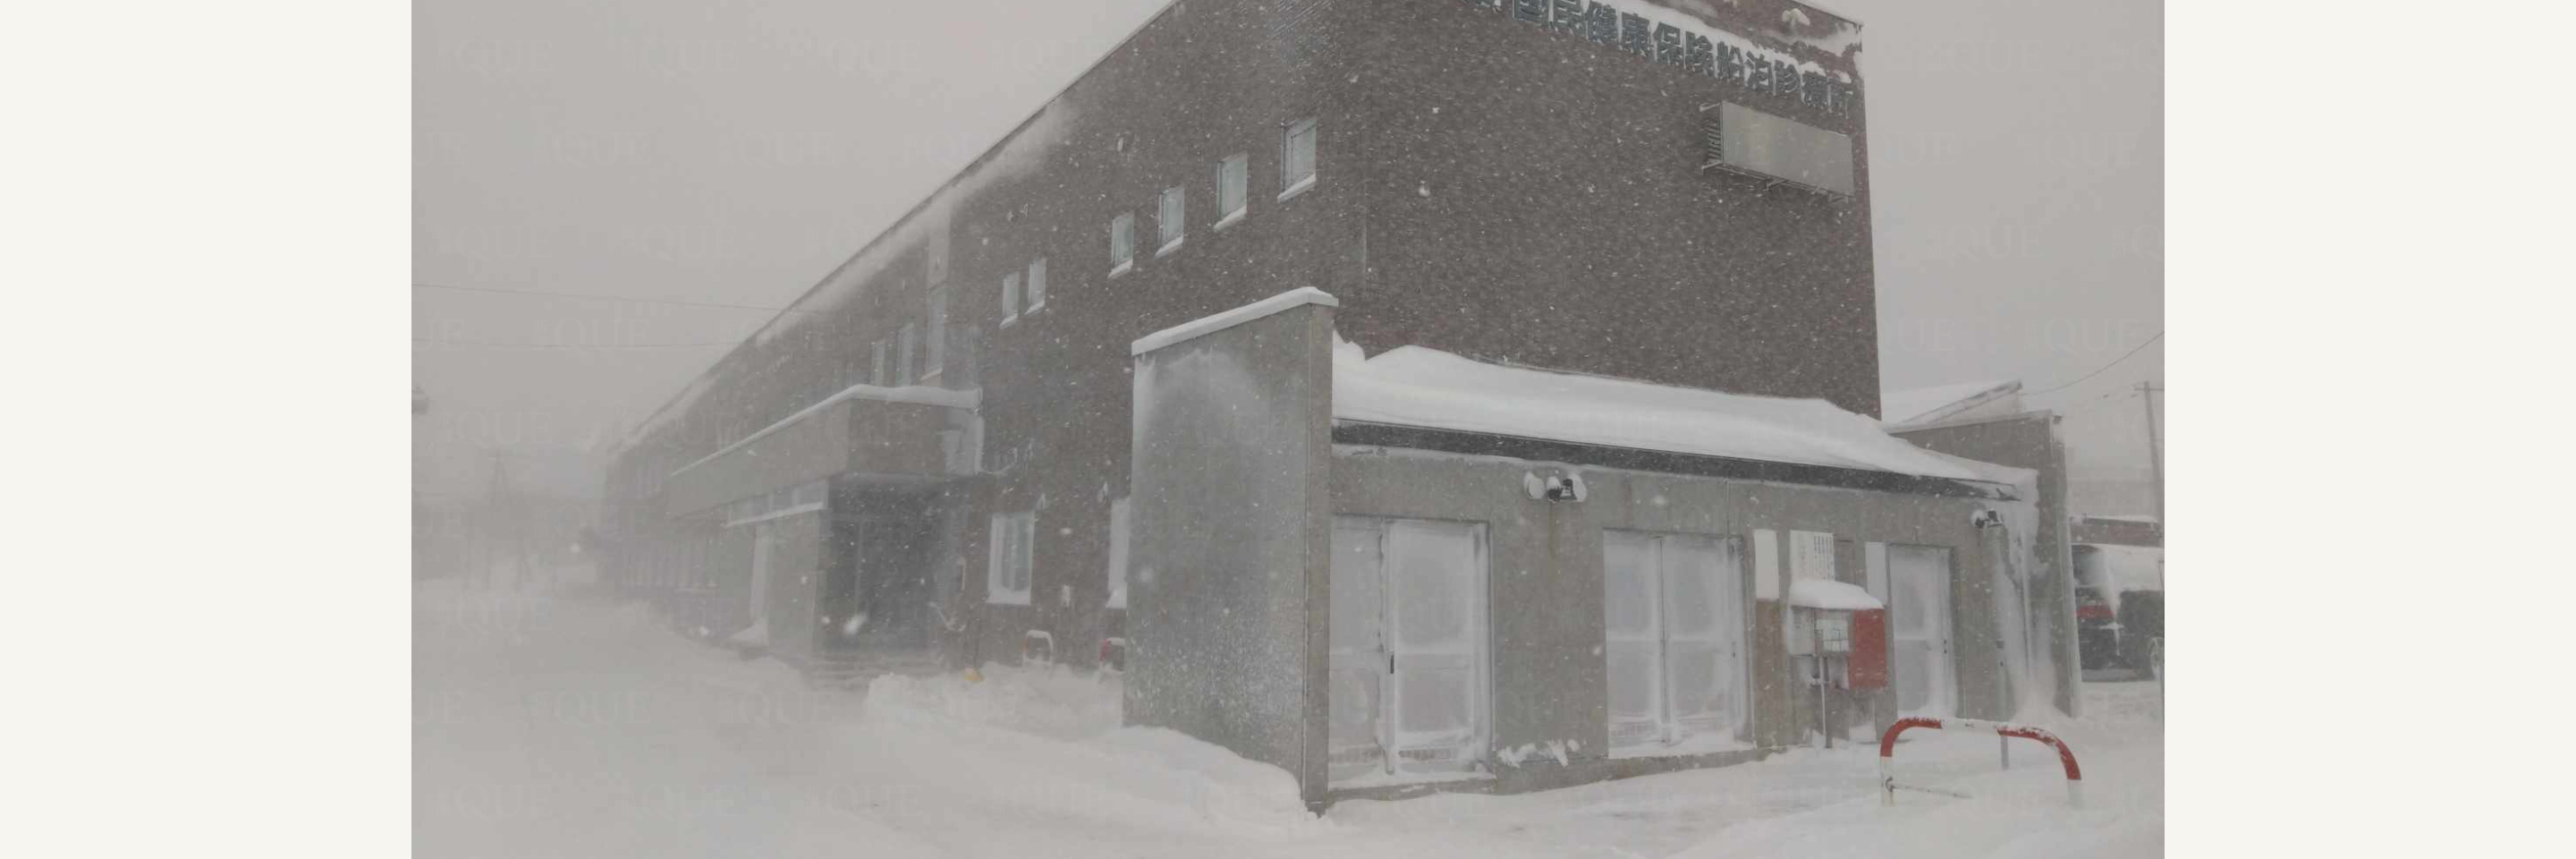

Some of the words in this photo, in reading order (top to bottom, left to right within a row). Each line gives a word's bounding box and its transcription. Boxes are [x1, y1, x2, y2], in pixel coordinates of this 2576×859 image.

[1475, 0, 1855, 115] 国民健康保険船泊診療所
